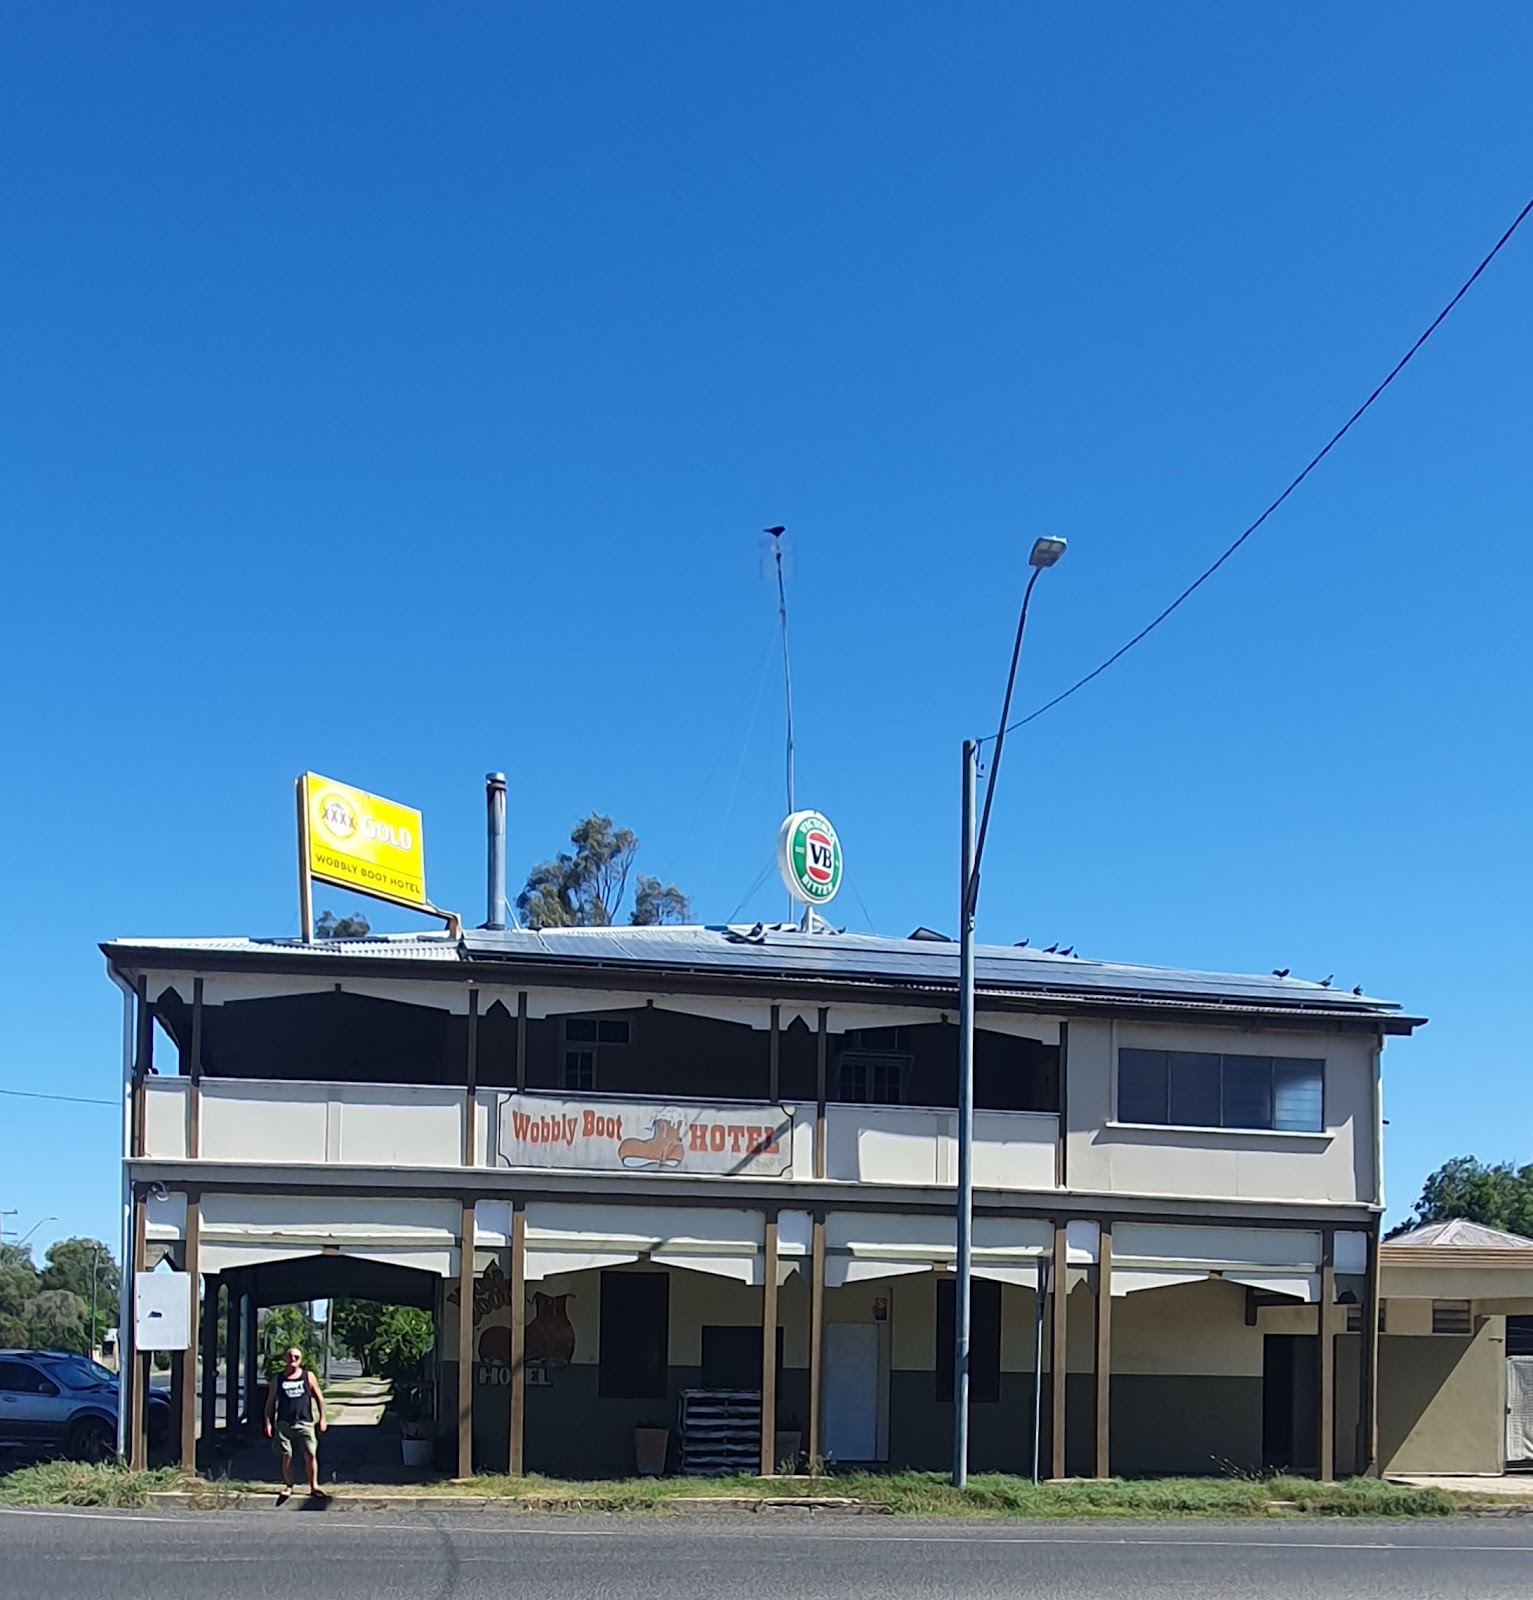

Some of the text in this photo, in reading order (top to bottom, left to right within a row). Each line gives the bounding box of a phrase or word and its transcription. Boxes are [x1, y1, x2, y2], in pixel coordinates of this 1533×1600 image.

[809, 842, 832, 869] VB
[315, 853, 421, 894] WOBBLY BOOT HOTEL
[511, 1109, 780, 1154] Wobbly Boot HOTEL
[478, 1366, 552, 1386] HOEL
